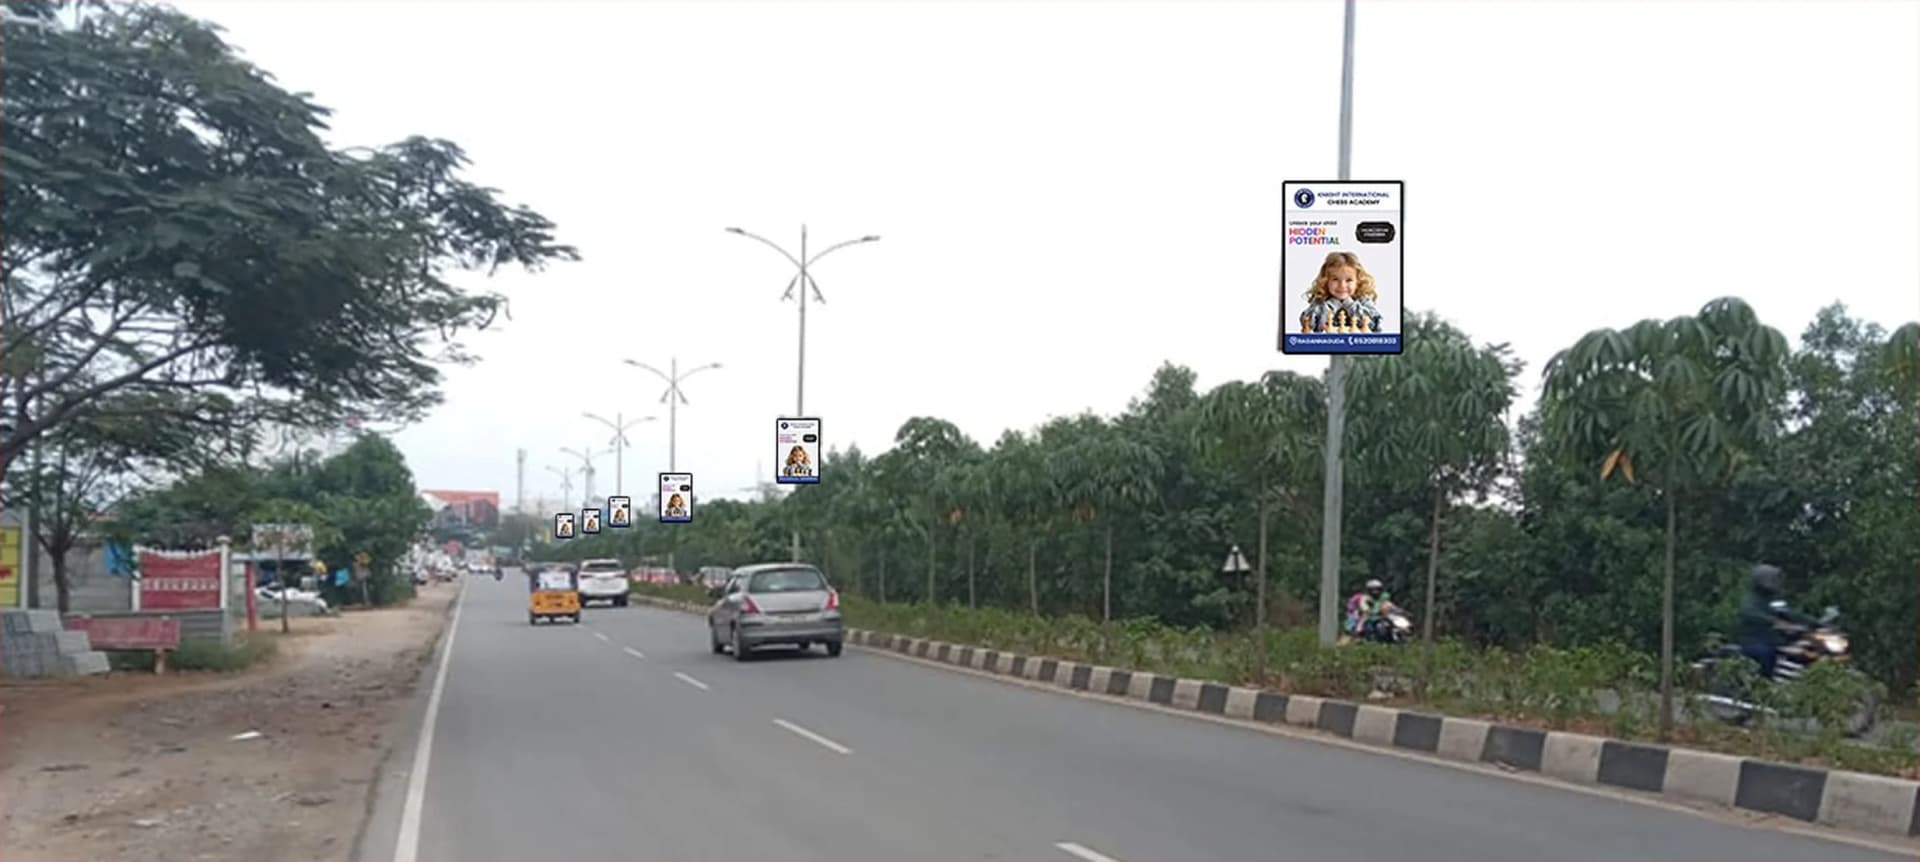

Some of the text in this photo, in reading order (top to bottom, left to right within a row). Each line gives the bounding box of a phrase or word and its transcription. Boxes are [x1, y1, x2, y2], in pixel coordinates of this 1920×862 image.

[1327, 198, 1380, 206] CHESS ACADEMY
[1289, 227, 1326, 236] HIDDEN
[1289, 236, 1340, 245] POTENTIAL
